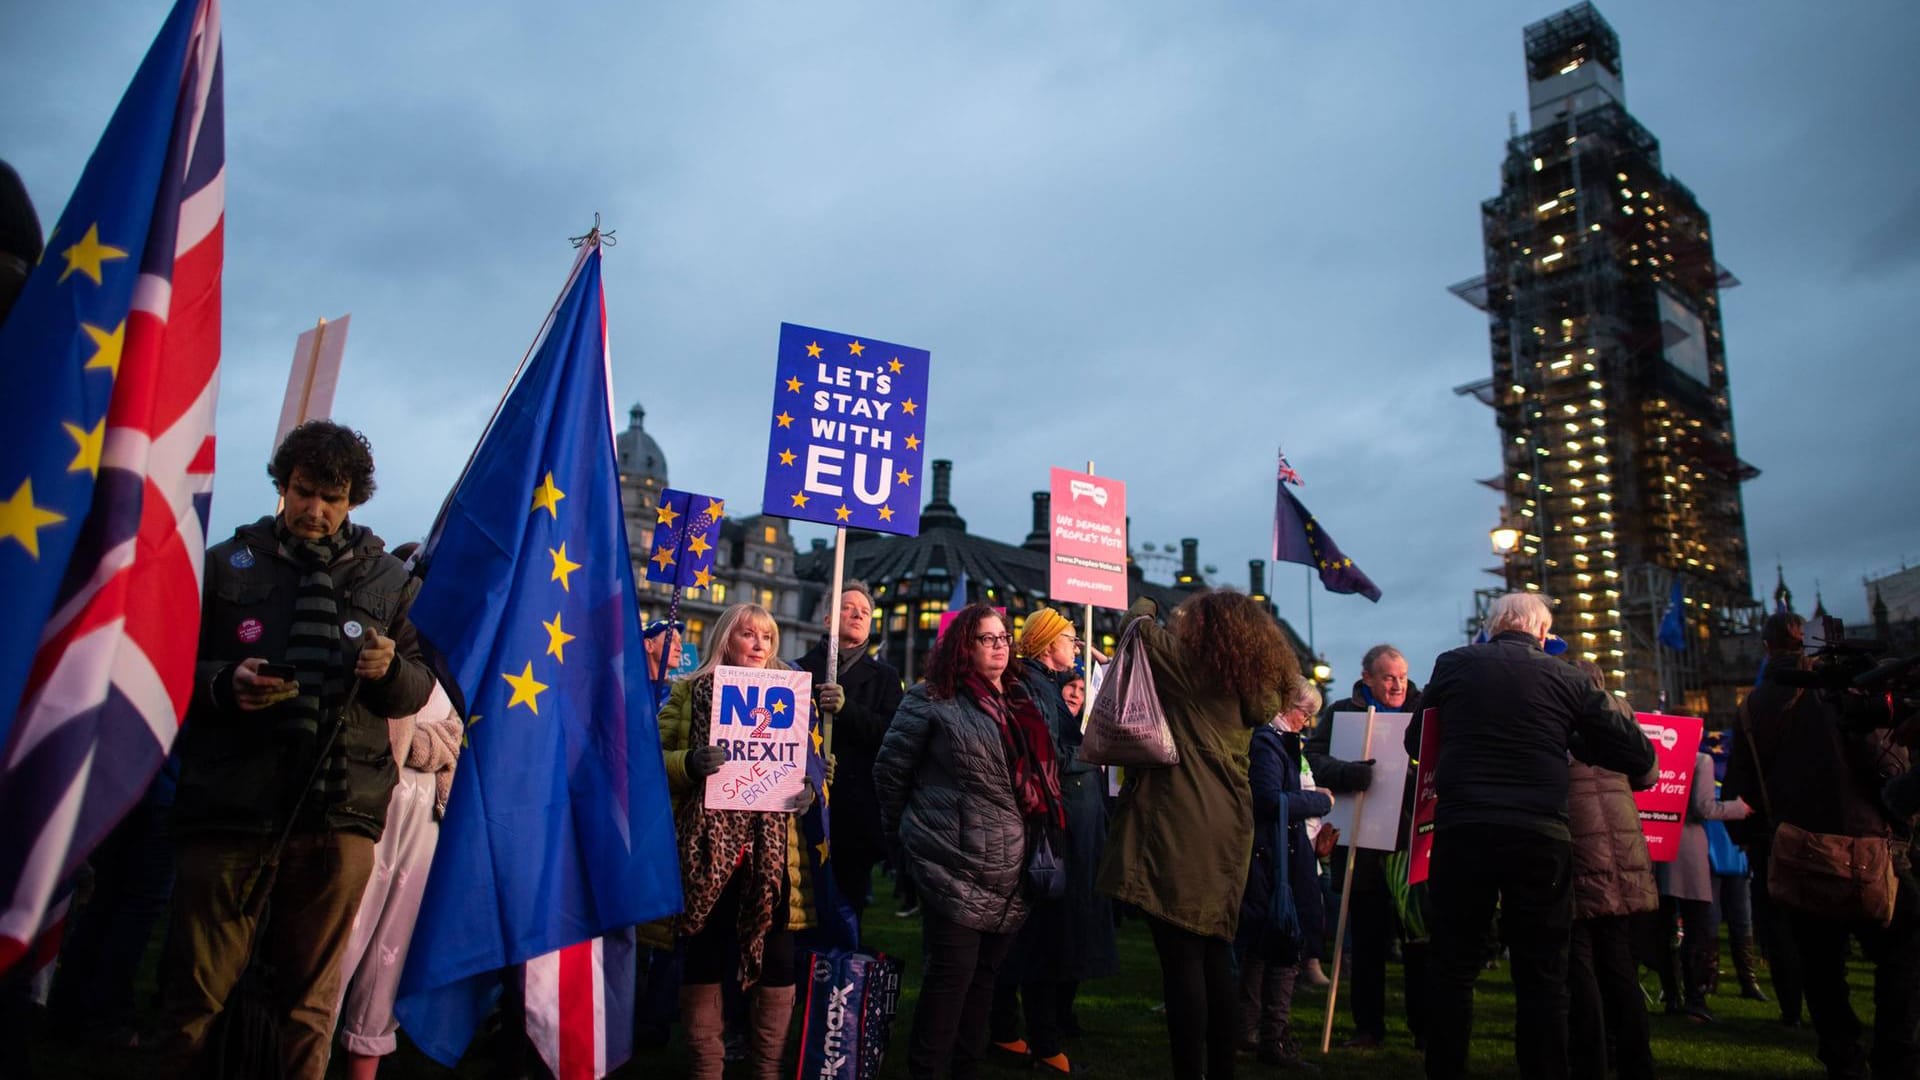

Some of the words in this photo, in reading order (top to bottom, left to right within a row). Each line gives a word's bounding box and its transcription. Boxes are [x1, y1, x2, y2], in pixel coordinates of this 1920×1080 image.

[817, 363, 892, 395] LET'S
[813, 391, 892, 421] STAY
[811, 417, 892, 450] WITH
[804, 444, 893, 505] EU
[1056, 514, 1073, 527] WE
[1075, 519, 1113, 534] DEMAND
[1115, 527, 1122, 536] A
[719, 684, 796, 729] NO
[750, 707, 772, 739] 2
[716, 738, 799, 762] BREXIT
[722, 761, 768, 800] SAVE
[741, 761, 798, 806] BRITAIN
[1660, 782, 1687, 795] VOTE
[1679, 771, 1687, 781] A
